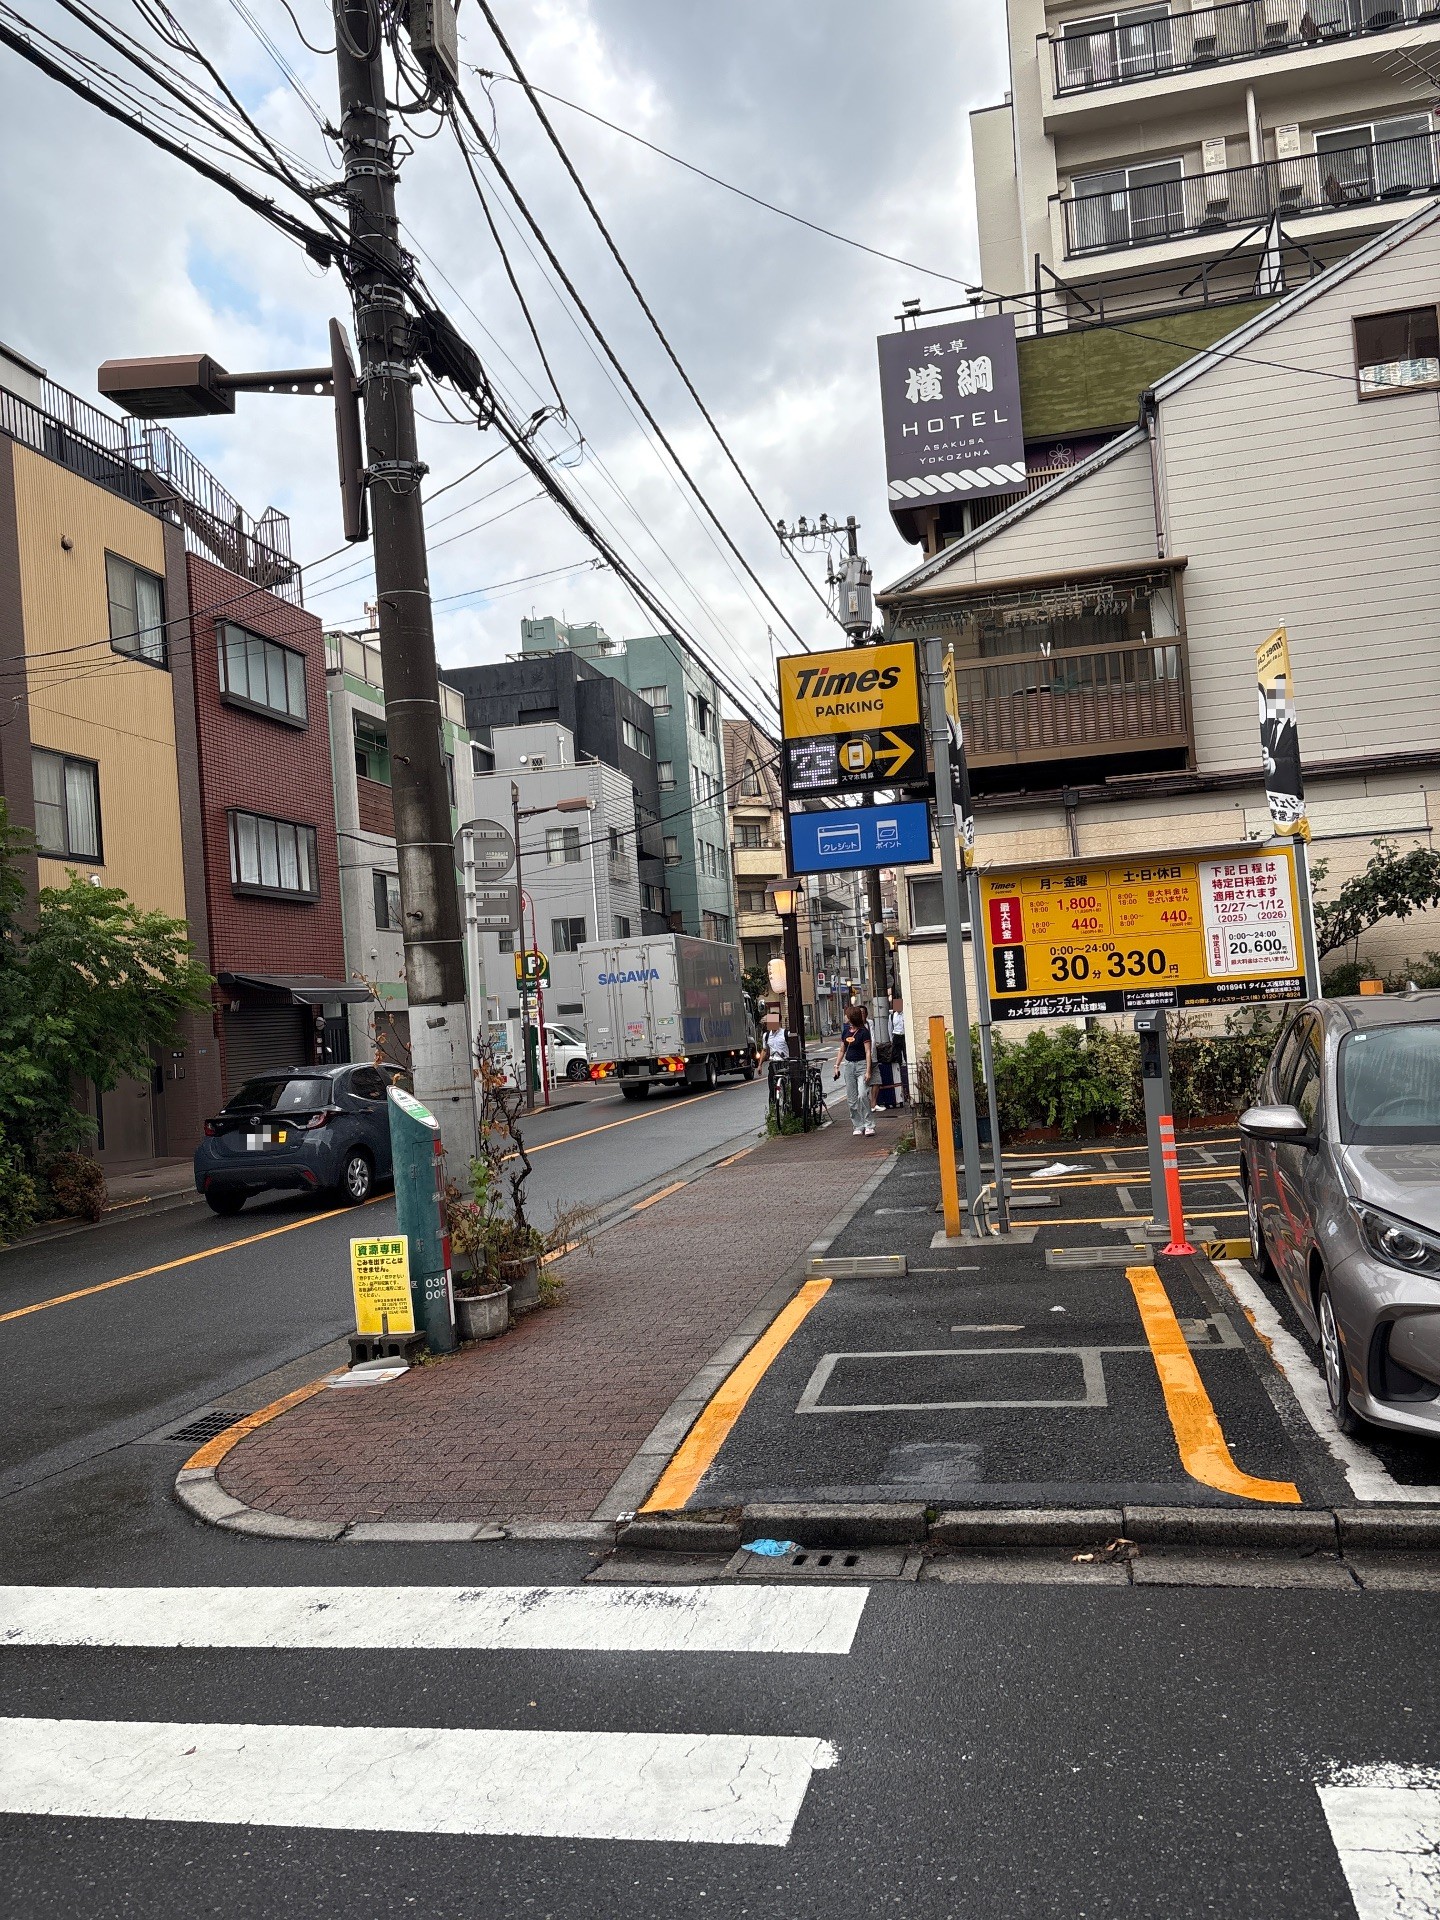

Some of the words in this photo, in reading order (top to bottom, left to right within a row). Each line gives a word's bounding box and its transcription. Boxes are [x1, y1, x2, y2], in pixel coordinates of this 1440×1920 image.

[923, 338, 968, 357] 浅草
[904, 355, 994, 404] 横綱
[902, 409, 1008, 438] HOTEL
[923, 437, 985, 452] ASAKUSA
[919, 449, 990, 465] YOKOZUNA
[795, 666, 902, 701] Times
[815, 699, 884, 718] PARKING
[790, 741, 839, 789] 空
[822, 841, 858, 852] クレジット
[875, 840, 902, 850] ポイント
[1211, 862, 1276, 877] 下記日程は
[990, 881, 1016, 890] Times
[1211, 873, 1277, 890] 特定日料金が
[1147, 887, 1189, 898] 最大料金は
[1147, 895, 1190, 905] ございません
[1212, 886, 1278, 902] 適用されます
[999, 902, 1013, 940] 最大料金
[597, 968, 660, 986] SAGAWA
[1003, 950, 1017, 988] 基本料金
[1007, 1001, 1107, 1017] カメラ認識システム駐車場
[1023, 995, 1089, 1008] ナンバープレート
[357, 1243, 401, 1257] 資源専用
[425, 1276, 447, 1288] 030
[425, 1288, 447, 1301] 006
